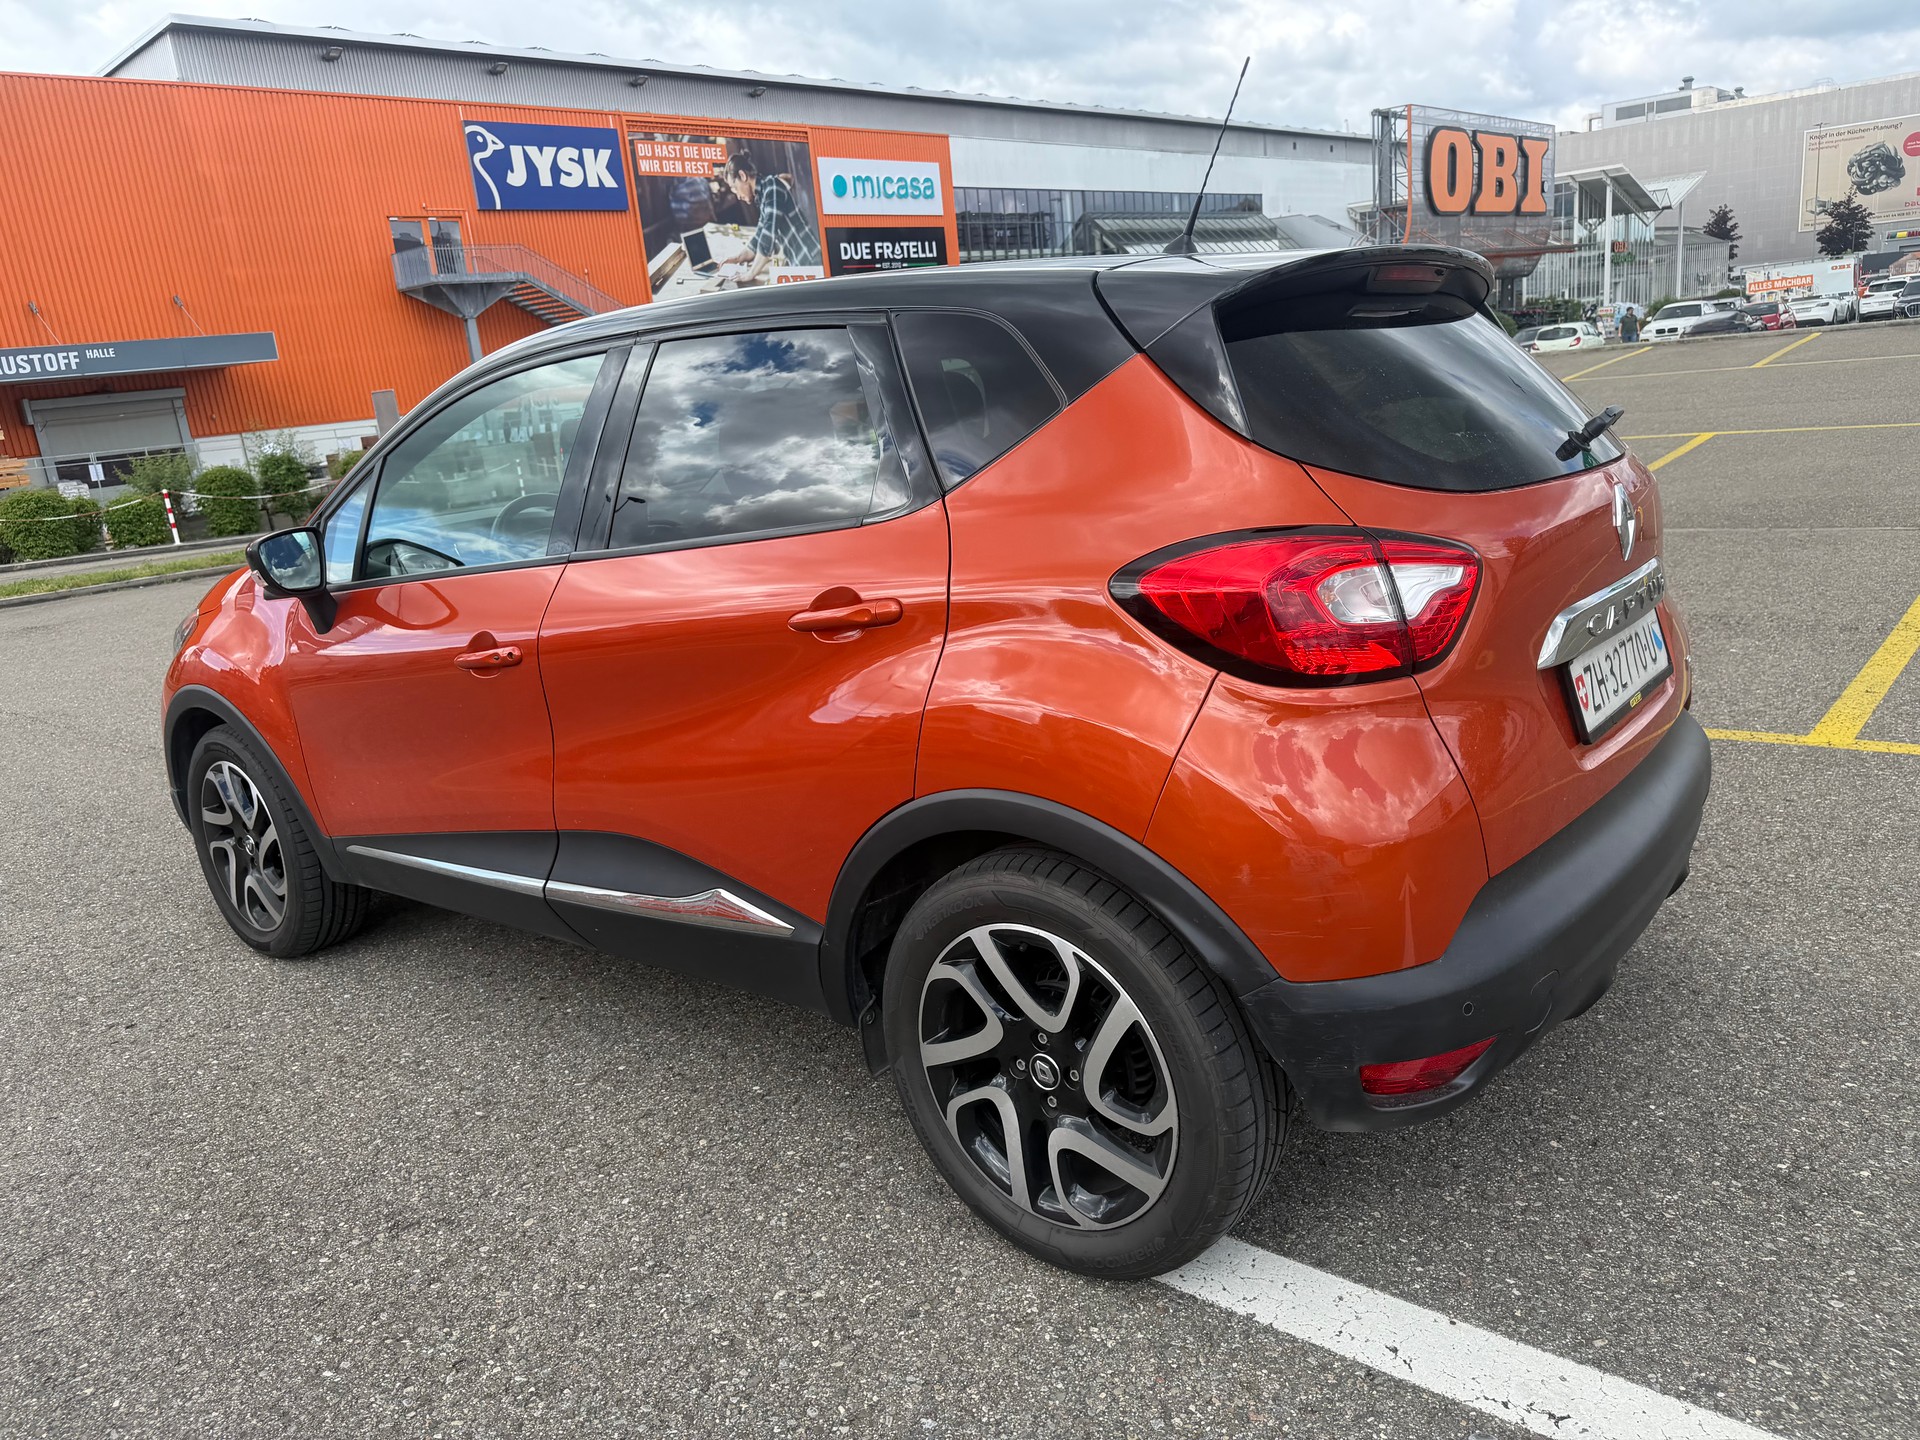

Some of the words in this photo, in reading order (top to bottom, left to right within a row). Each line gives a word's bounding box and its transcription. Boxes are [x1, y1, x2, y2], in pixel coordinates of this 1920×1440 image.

[637, 143, 652, 157] DU
[654, 144, 681, 158] HAST
[683, 146, 700, 159] DIE
[701, 147, 726, 160] IDEE.
[506, 145, 619, 188] JYSK
[639, 159, 661, 172] WIR
[662, 160, 683, 173] DEN
[684, 161, 712, 174] REST.
[1424, 126, 1549, 216] OBI
[852, 175, 935, 199] micasa
[840, 243, 872, 260] DUE
[875, 241, 937, 259] FRATELLI
[1830, 263, 1852, 271] OBI
[1750, 279, 1773, 292] ALLES
[1774, 275, 1812, 289] MACHBAR
[85, 348, 116, 359] HALLE
